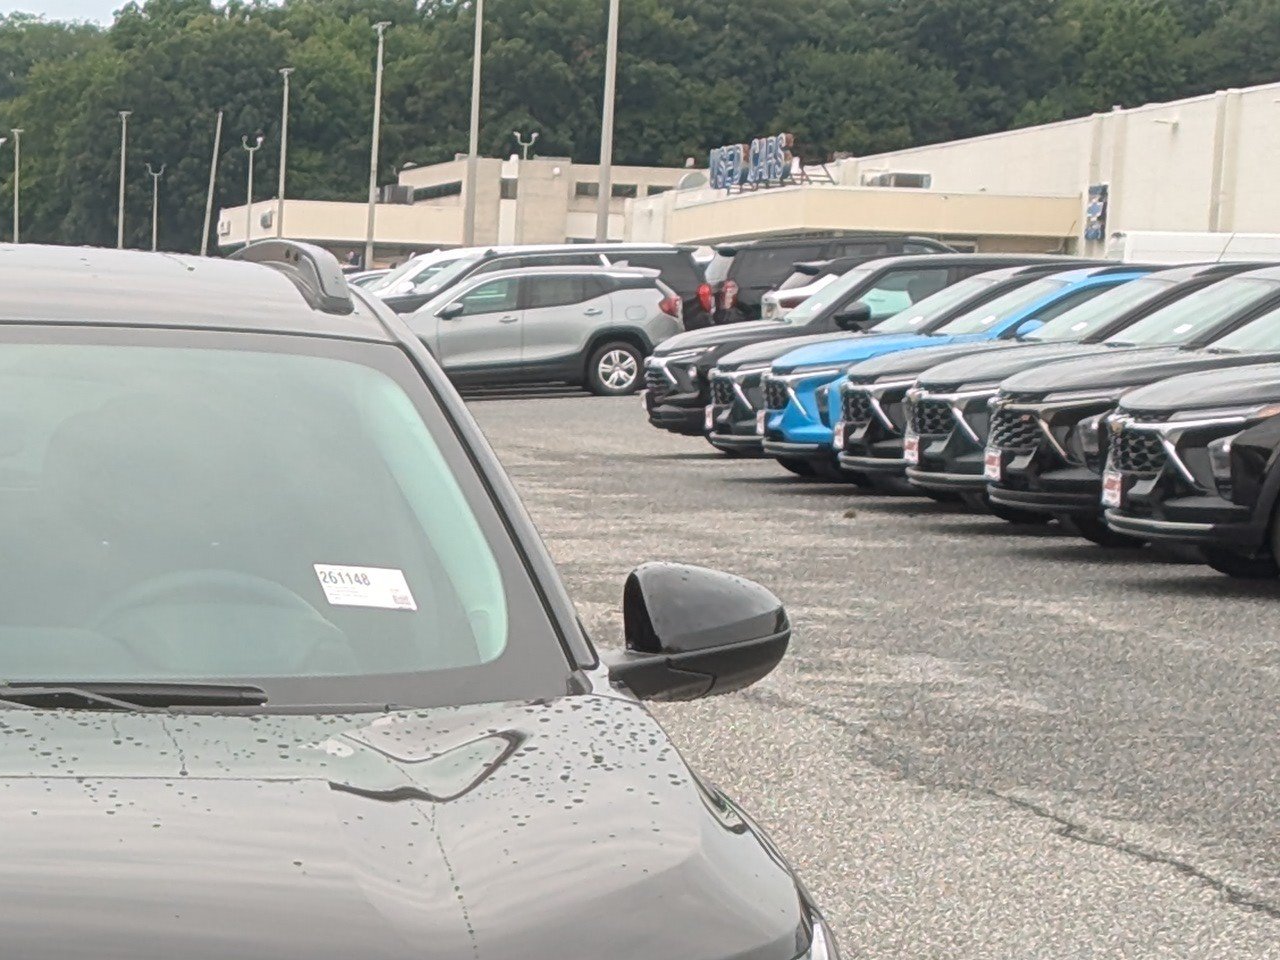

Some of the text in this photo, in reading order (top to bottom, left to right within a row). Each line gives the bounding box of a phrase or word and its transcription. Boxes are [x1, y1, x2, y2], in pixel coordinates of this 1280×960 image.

[710, 133, 794, 189] USED CARS
[320, 571, 371, 586] 261148
